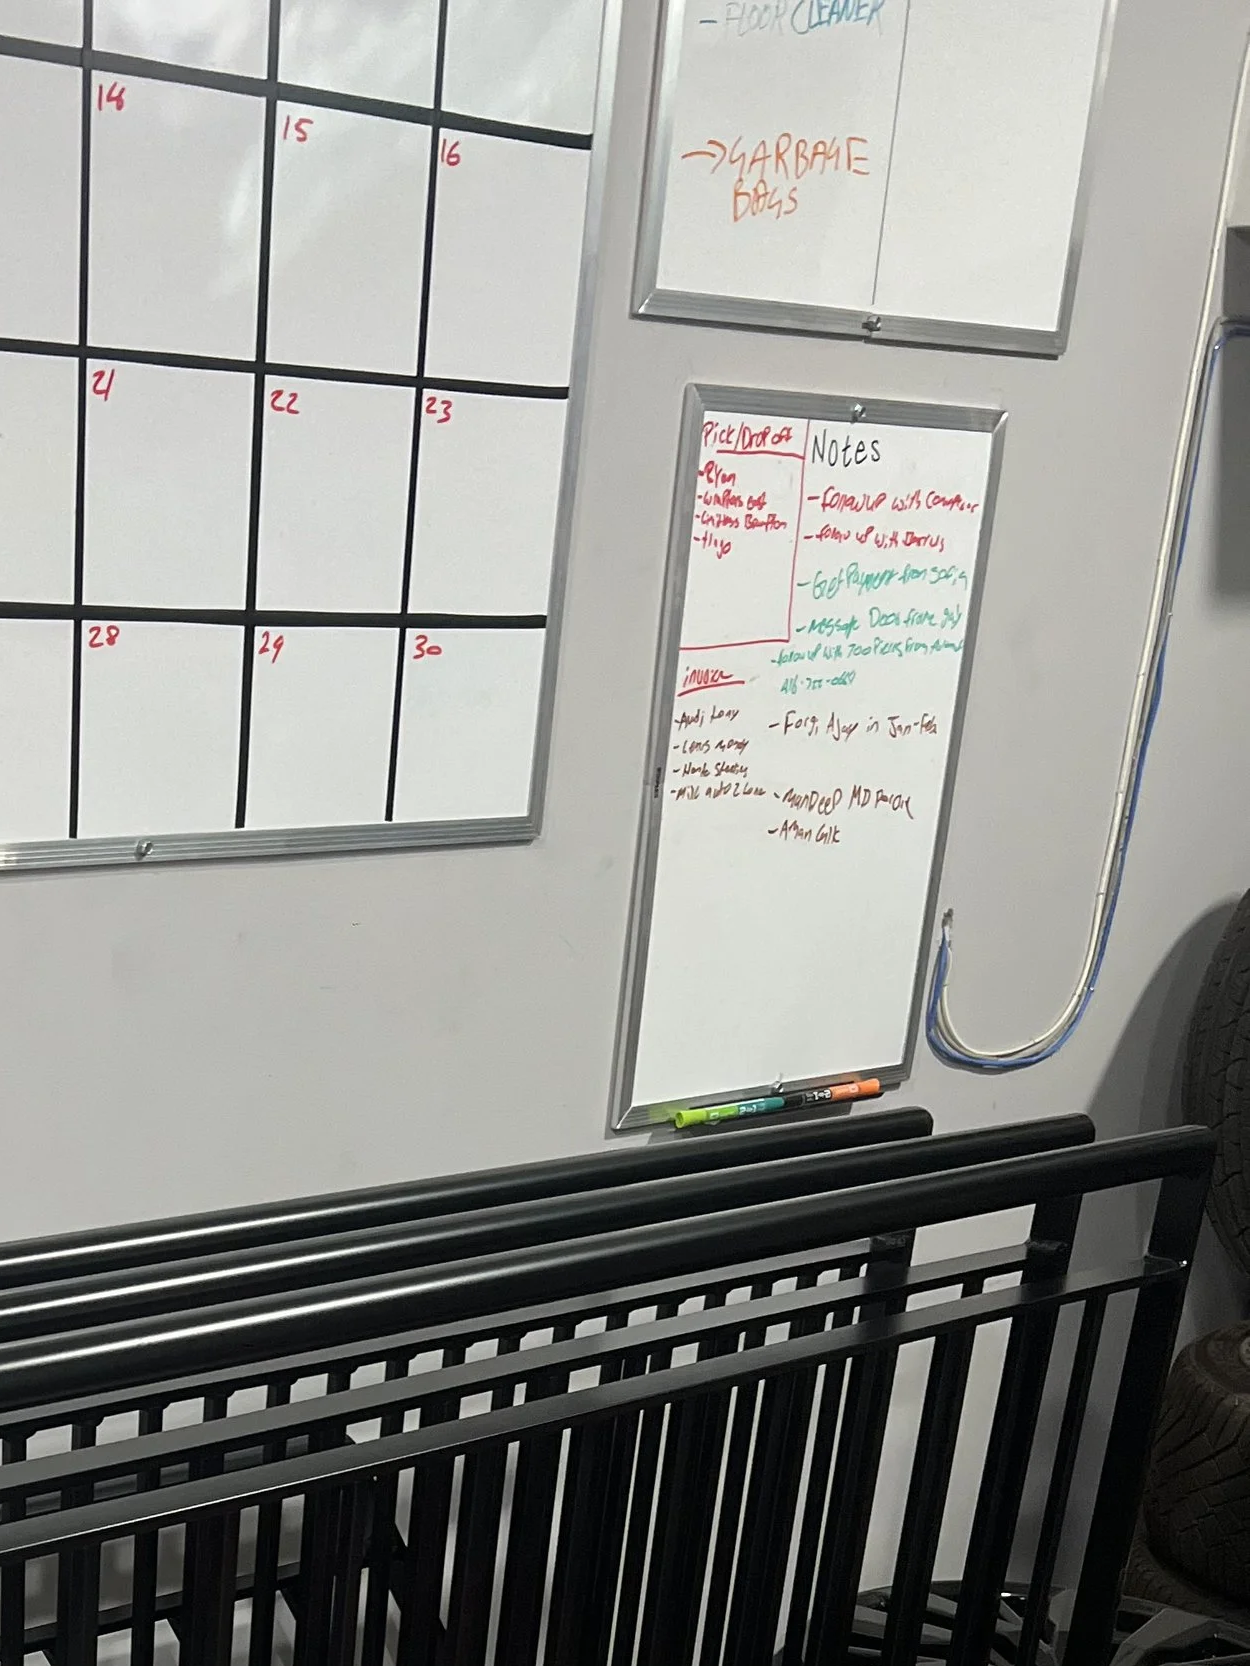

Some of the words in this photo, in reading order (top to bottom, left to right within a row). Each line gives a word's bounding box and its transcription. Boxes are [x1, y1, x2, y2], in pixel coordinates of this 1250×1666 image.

[97, 82, 126, 111] 14
[283, 116, 312, 143] 15
[439, 140, 461, 167] 16
[729, 133, 869, 180] GARBAGE
[732, 180, 798, 222] BAGS
[92, 369, 116, 400] 21
[270, 389, 300, 415] 22
[424, 395, 453, 424] 23
[812, 429, 881, 467] Notes
[88, 624, 120, 649] 28
[258, 632, 285, 664] 29
[412, 635, 443, 660] 30
